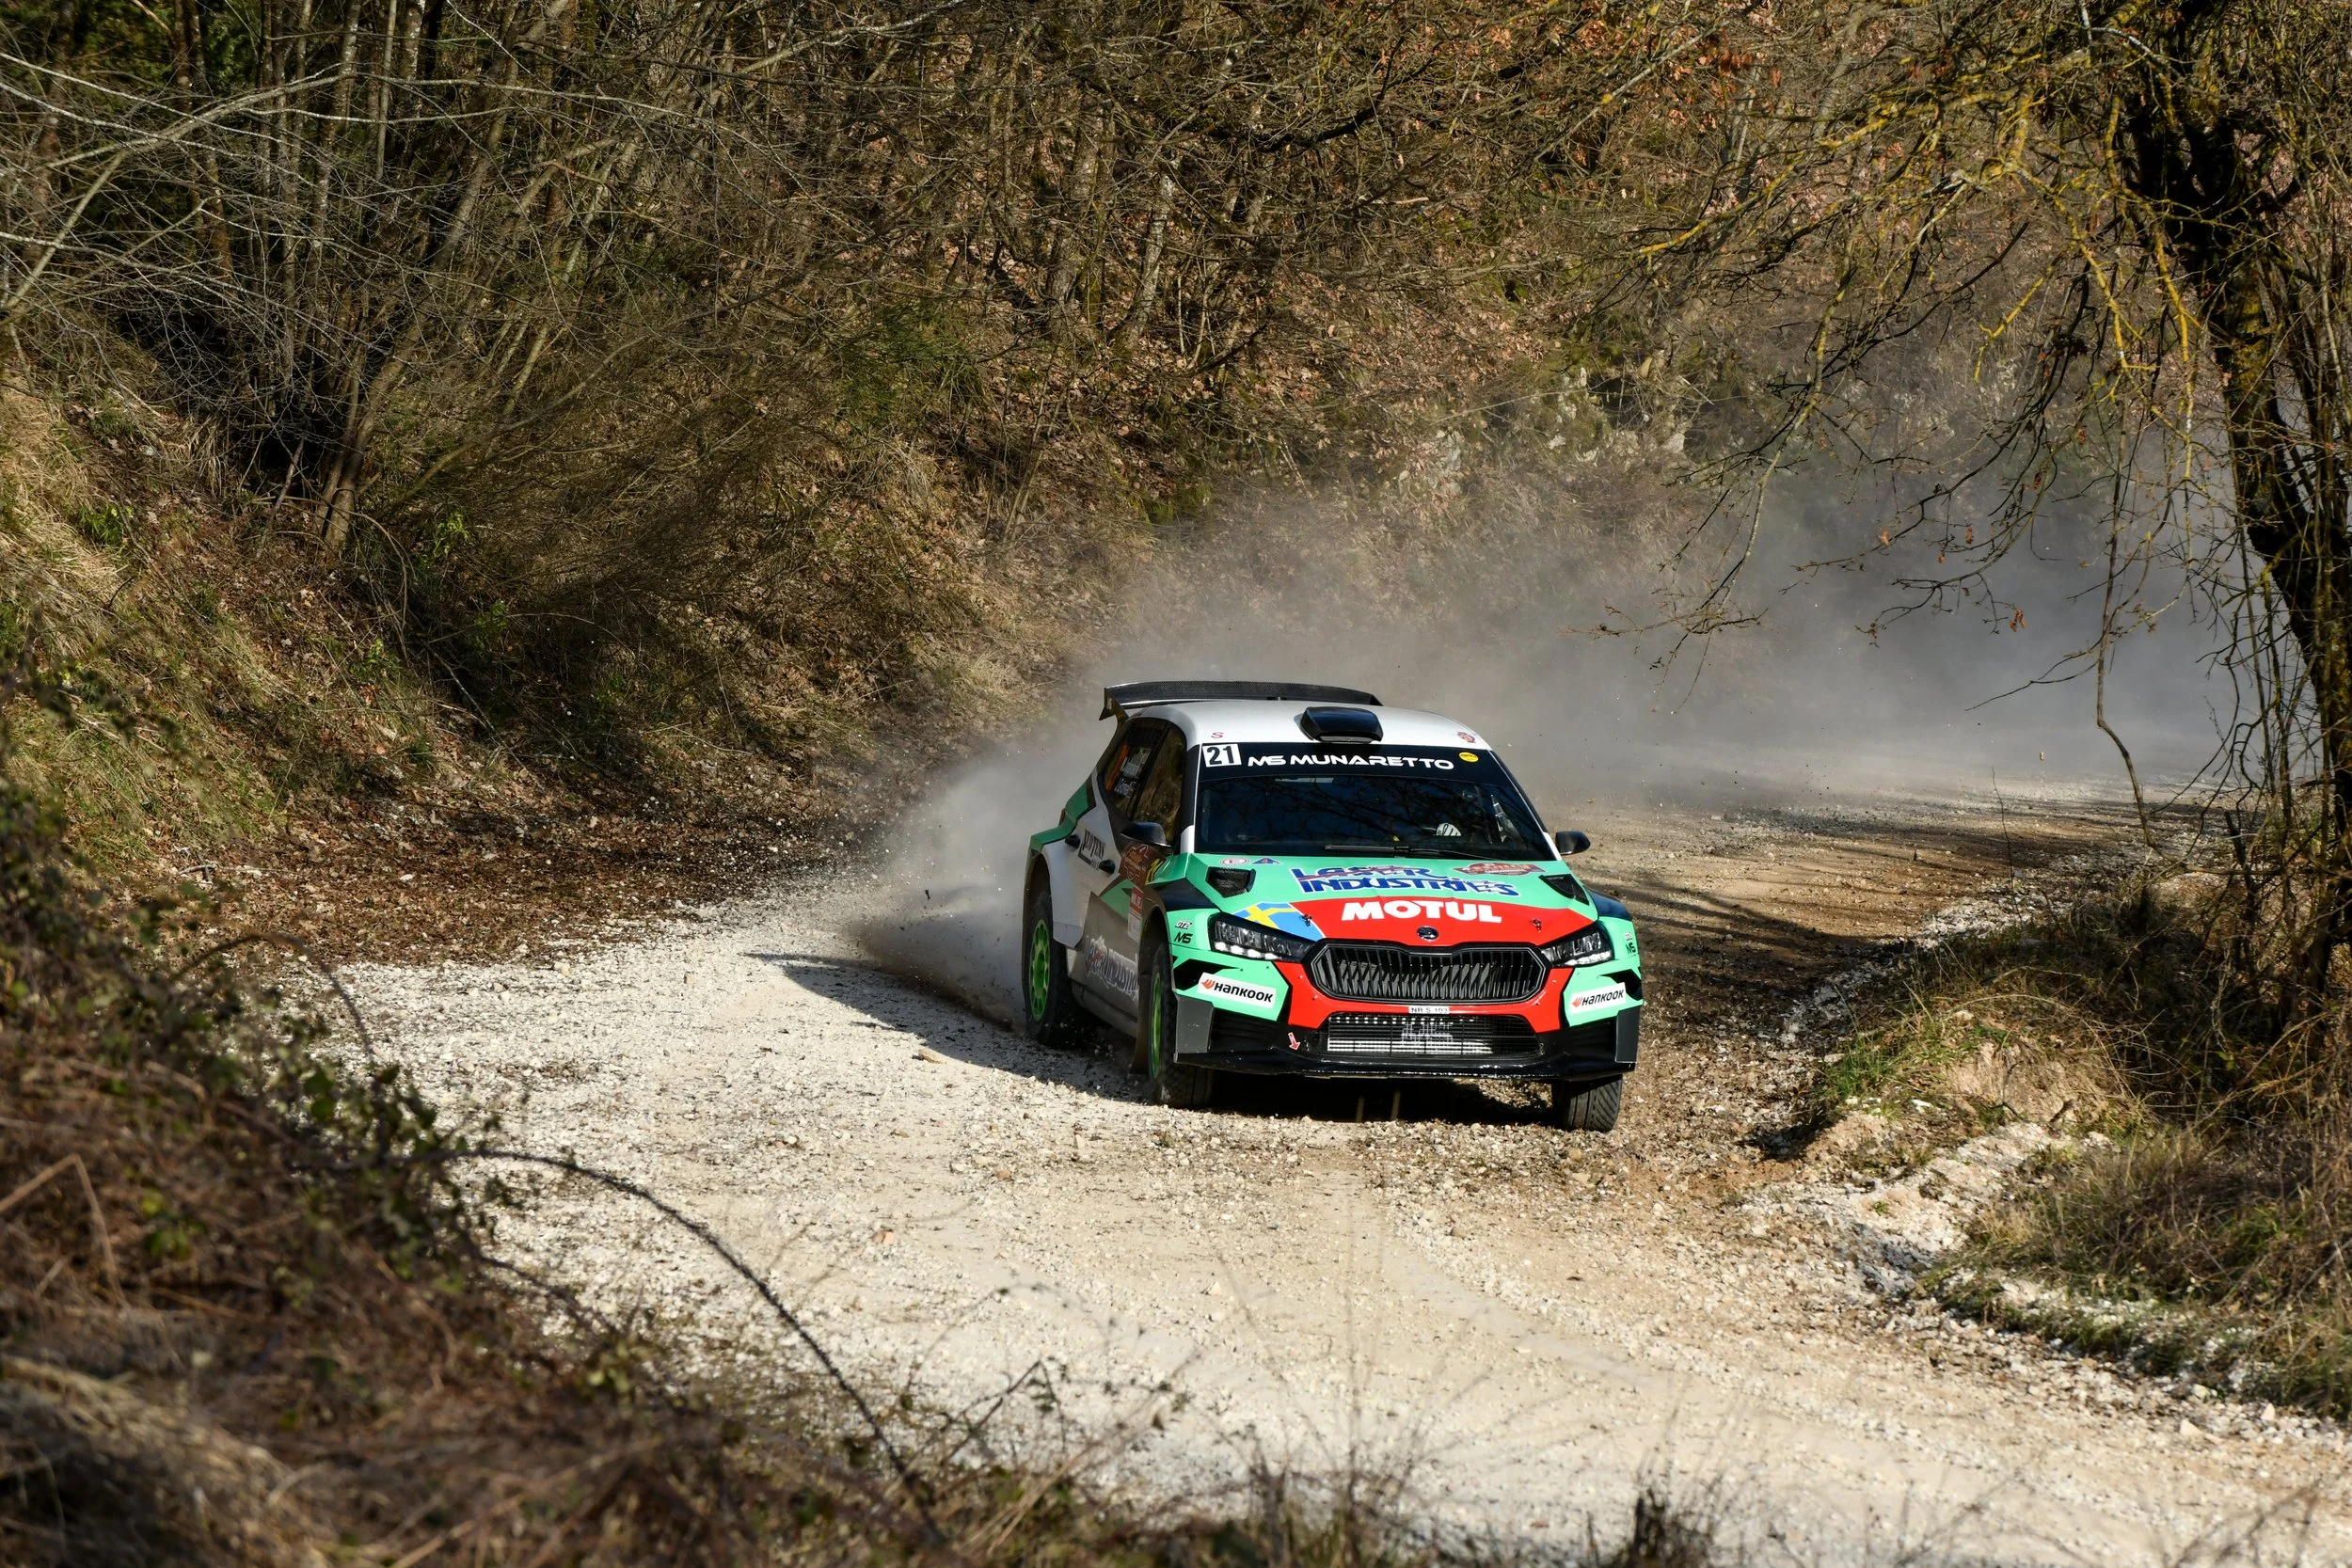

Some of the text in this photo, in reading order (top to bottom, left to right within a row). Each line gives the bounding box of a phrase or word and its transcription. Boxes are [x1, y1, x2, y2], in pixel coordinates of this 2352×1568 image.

[1207, 745, 1234, 766] 21
[1290, 754, 1454, 770] MUNARETTO
[1290, 865, 1449, 880] LASER
[1298, 877, 1520, 896] INDUSTRIES
[1342, 900, 1502, 924] MOTUL
